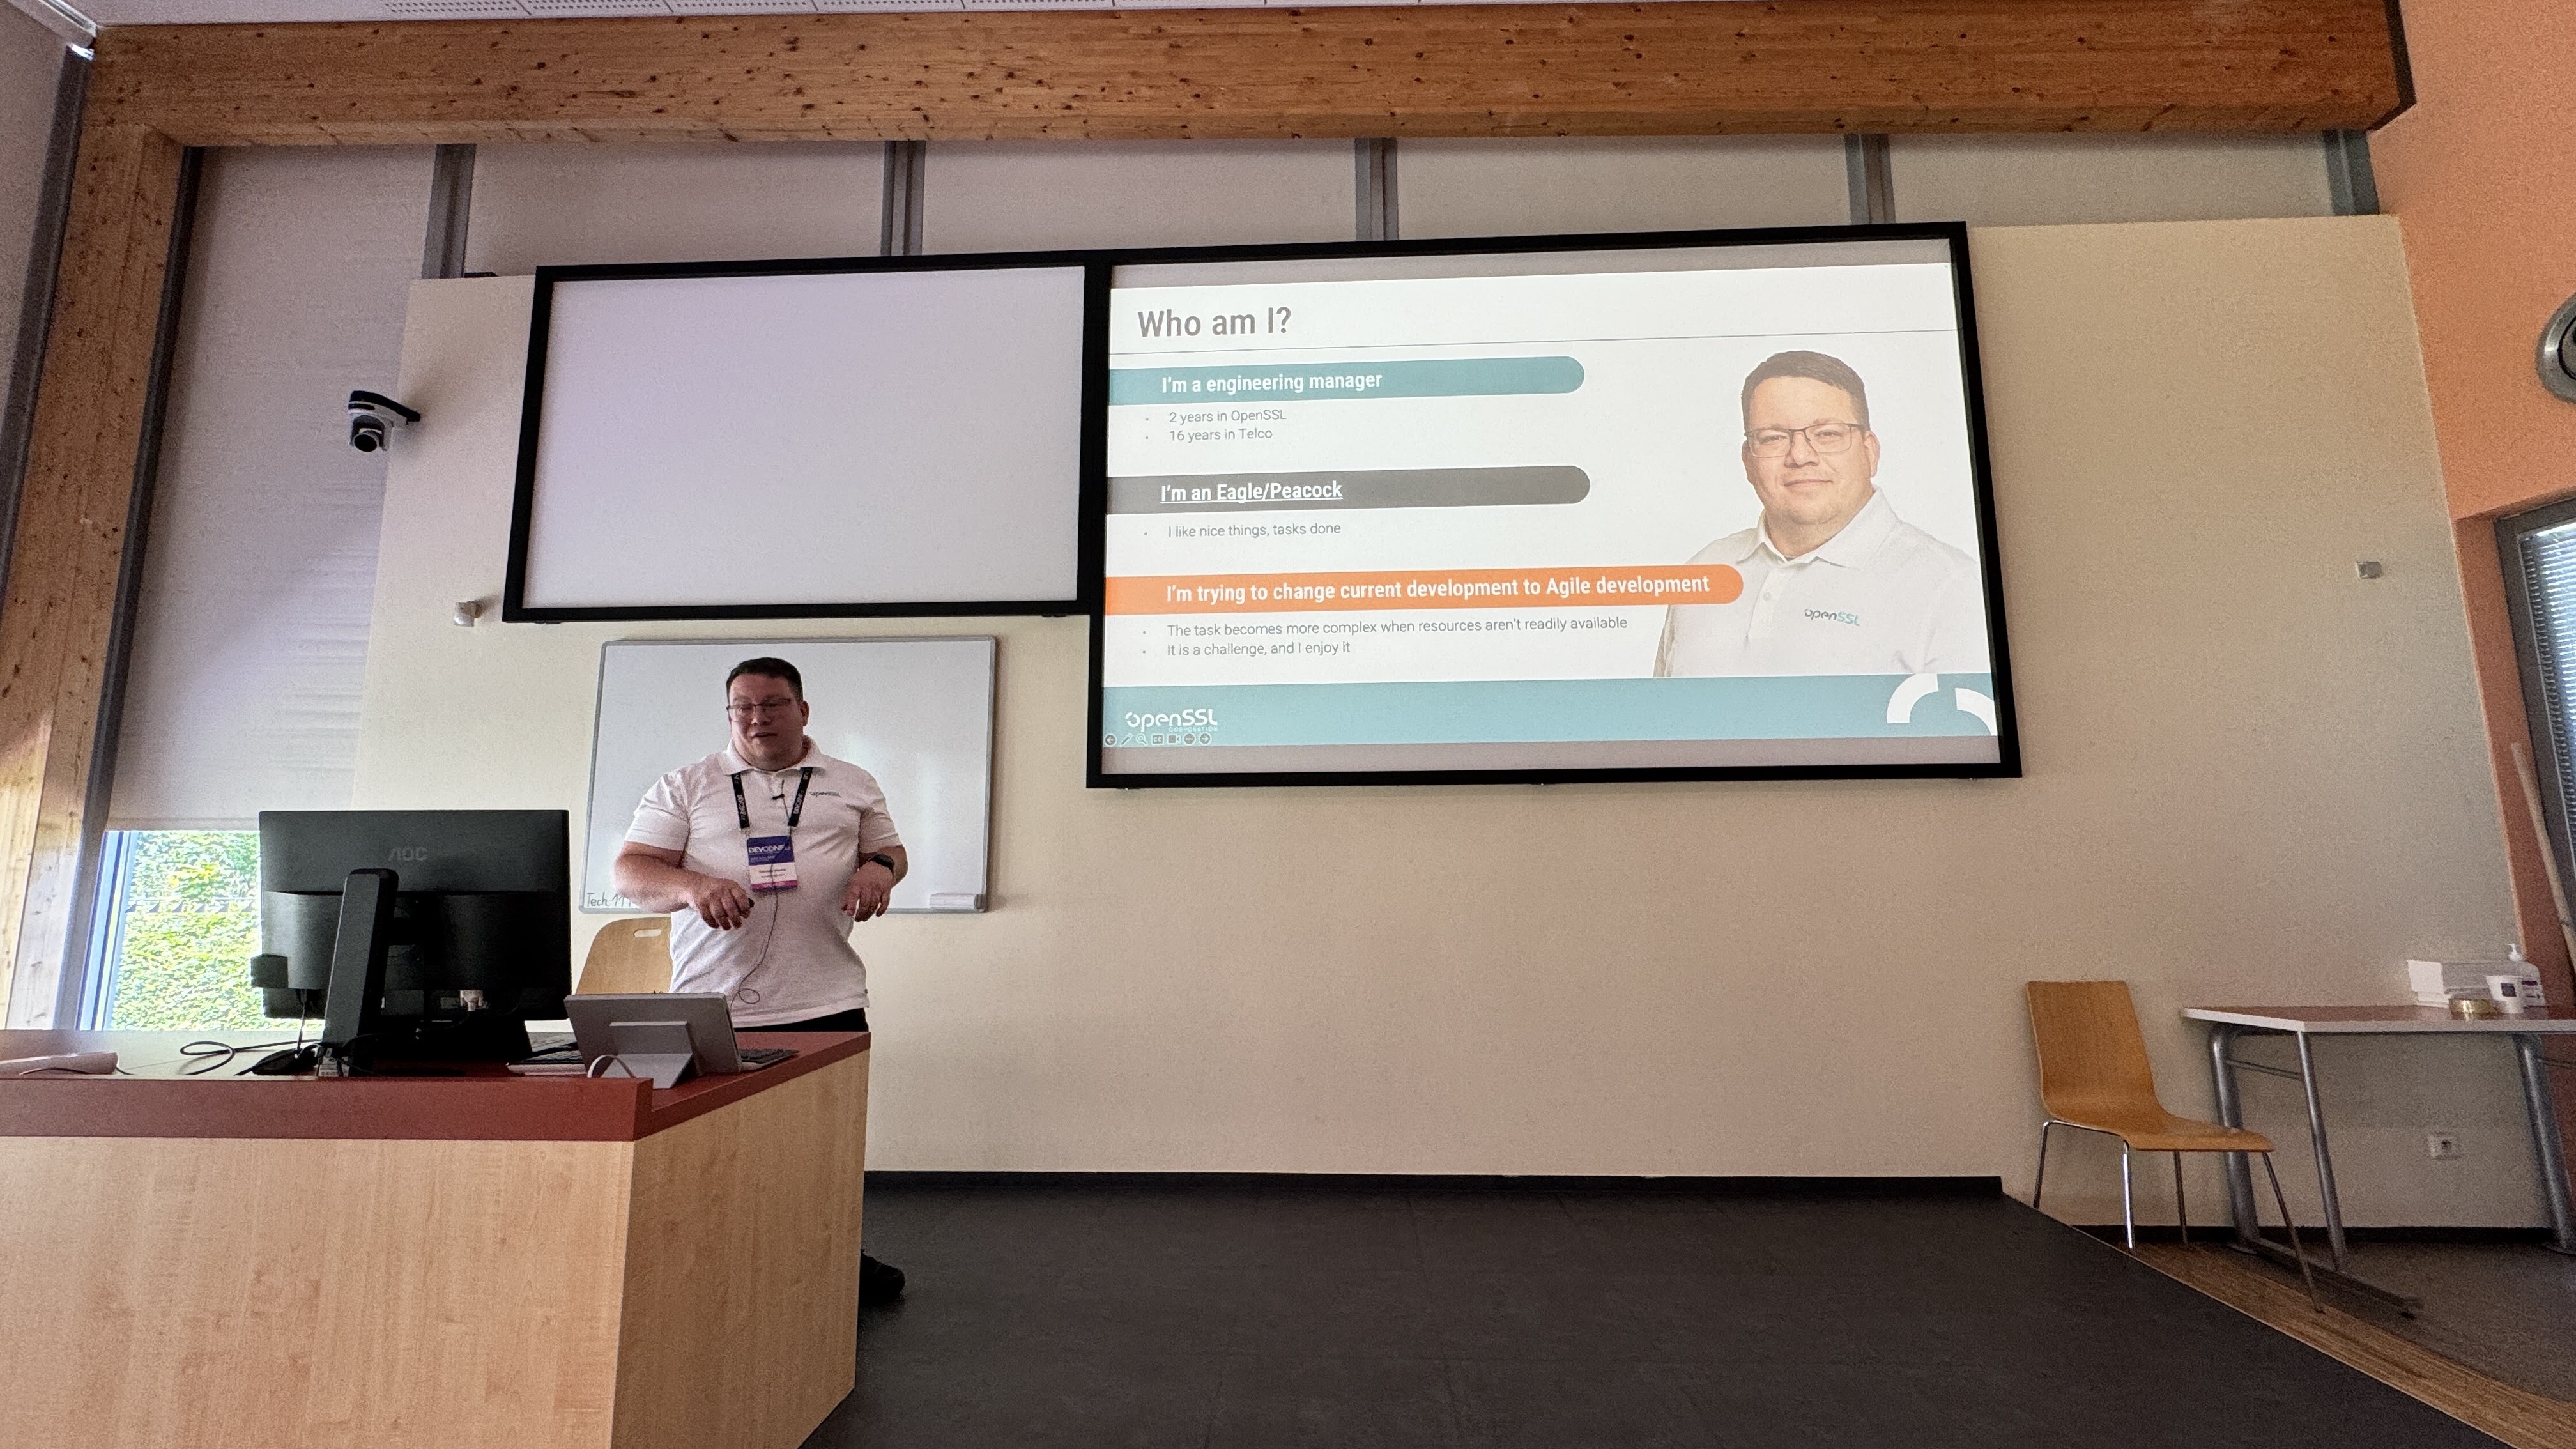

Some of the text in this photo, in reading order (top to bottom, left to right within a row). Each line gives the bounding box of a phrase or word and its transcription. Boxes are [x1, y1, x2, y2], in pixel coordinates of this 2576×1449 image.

[1138, 307, 1291, 337] Who am I?
[1163, 374, 1382, 395] I'm a engineering manager
[1170, 410, 1287, 425] 2 years in OpenSSL
[1170, 427, 1273, 443] 16 years in Telco
[1162, 480, 1342, 503] I'm an Eagle/Peacock
[1168, 523, 1341, 538] I like nice things, tasks done
[1167, 576, 1710, 605] I'm trying to change current development to Agile development
[1167, 617, 1627, 636] The task becomes more complex when resources aren't readily available
[1804, 608, 1860, 627] openSSL
[1168, 641, 1350, 657] It is a challenge, and I enjoy it
[1125, 709, 1218, 732] openSSL
[388, 847, 427, 861] AOC
[587, 891, 610, 907] Tech
